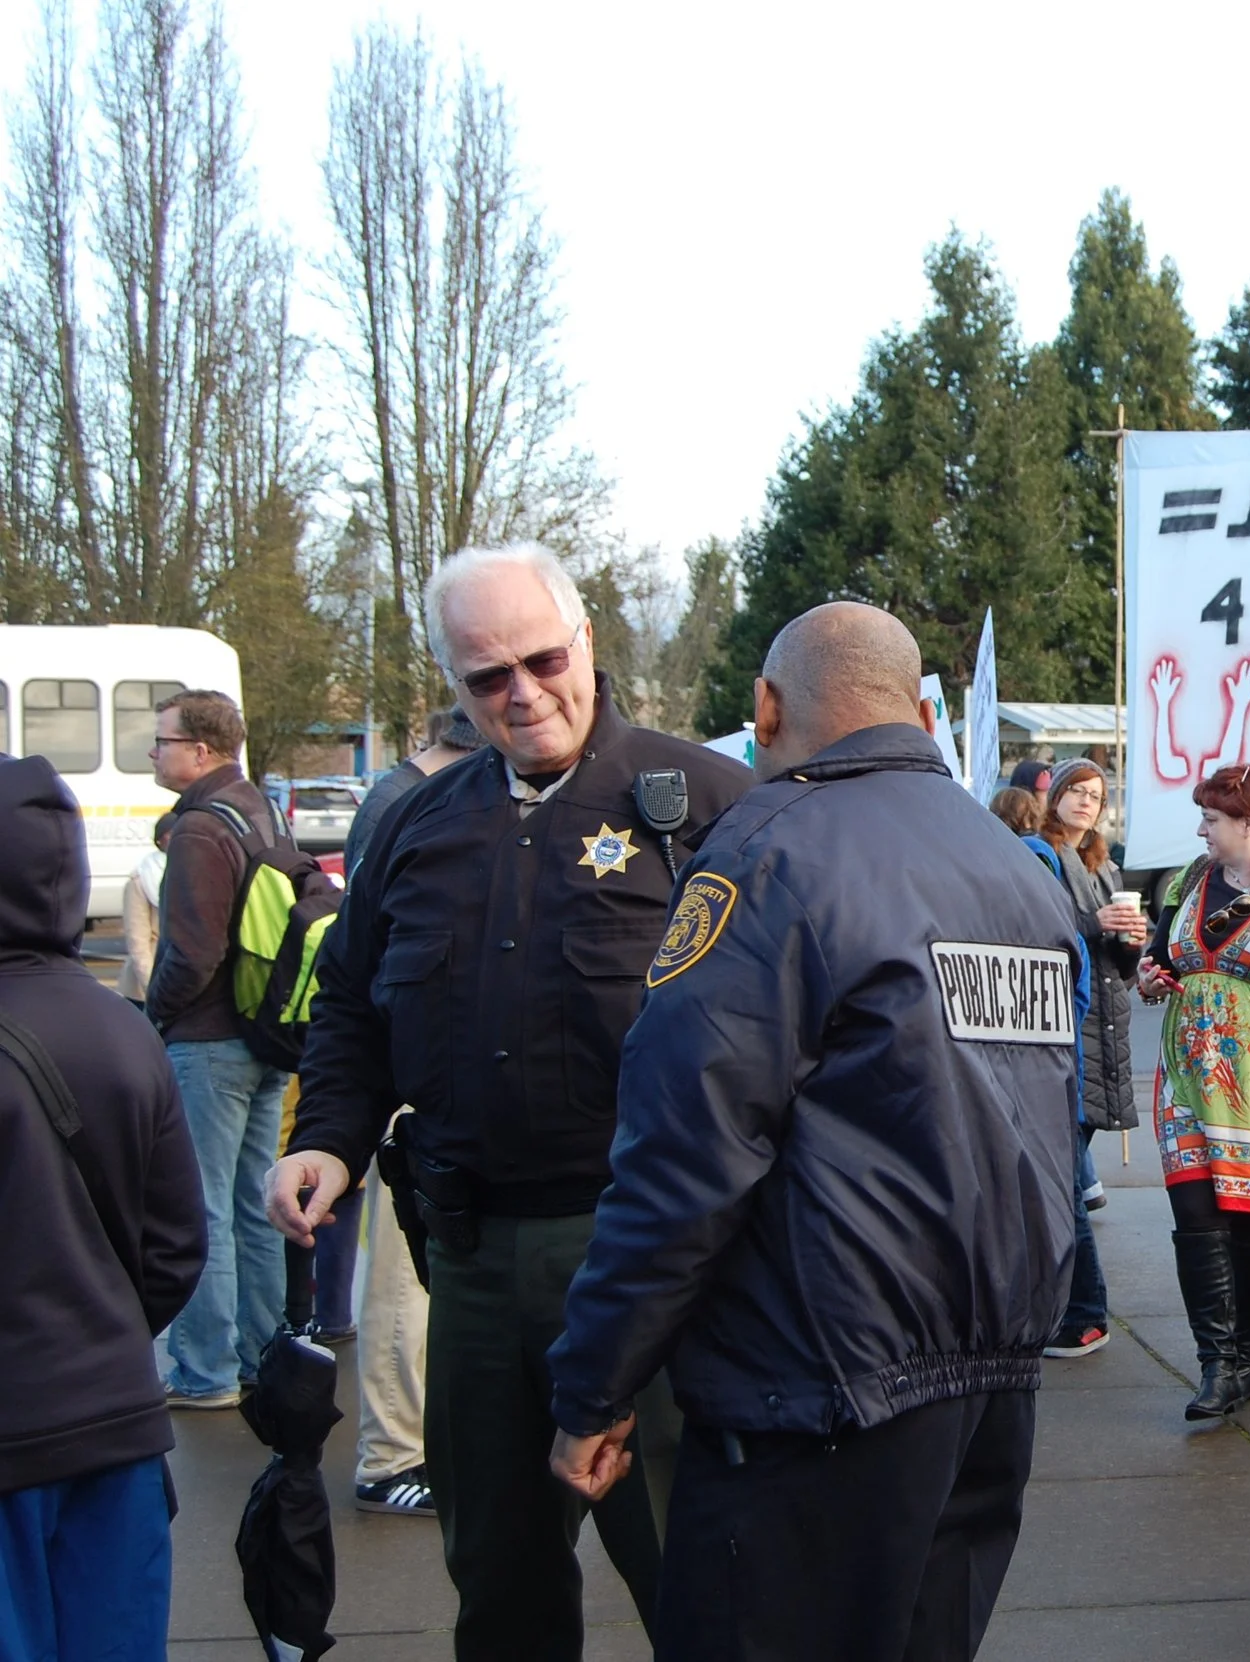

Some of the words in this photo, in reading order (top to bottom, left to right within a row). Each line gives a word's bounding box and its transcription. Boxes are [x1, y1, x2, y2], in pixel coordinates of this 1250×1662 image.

[1200, 577, 1243, 645] 4
[698, 884, 727, 903] SAFETY
[937, 953, 1004, 1028] PUBLIC
[1008, 957, 1071, 1032] SAFETY
